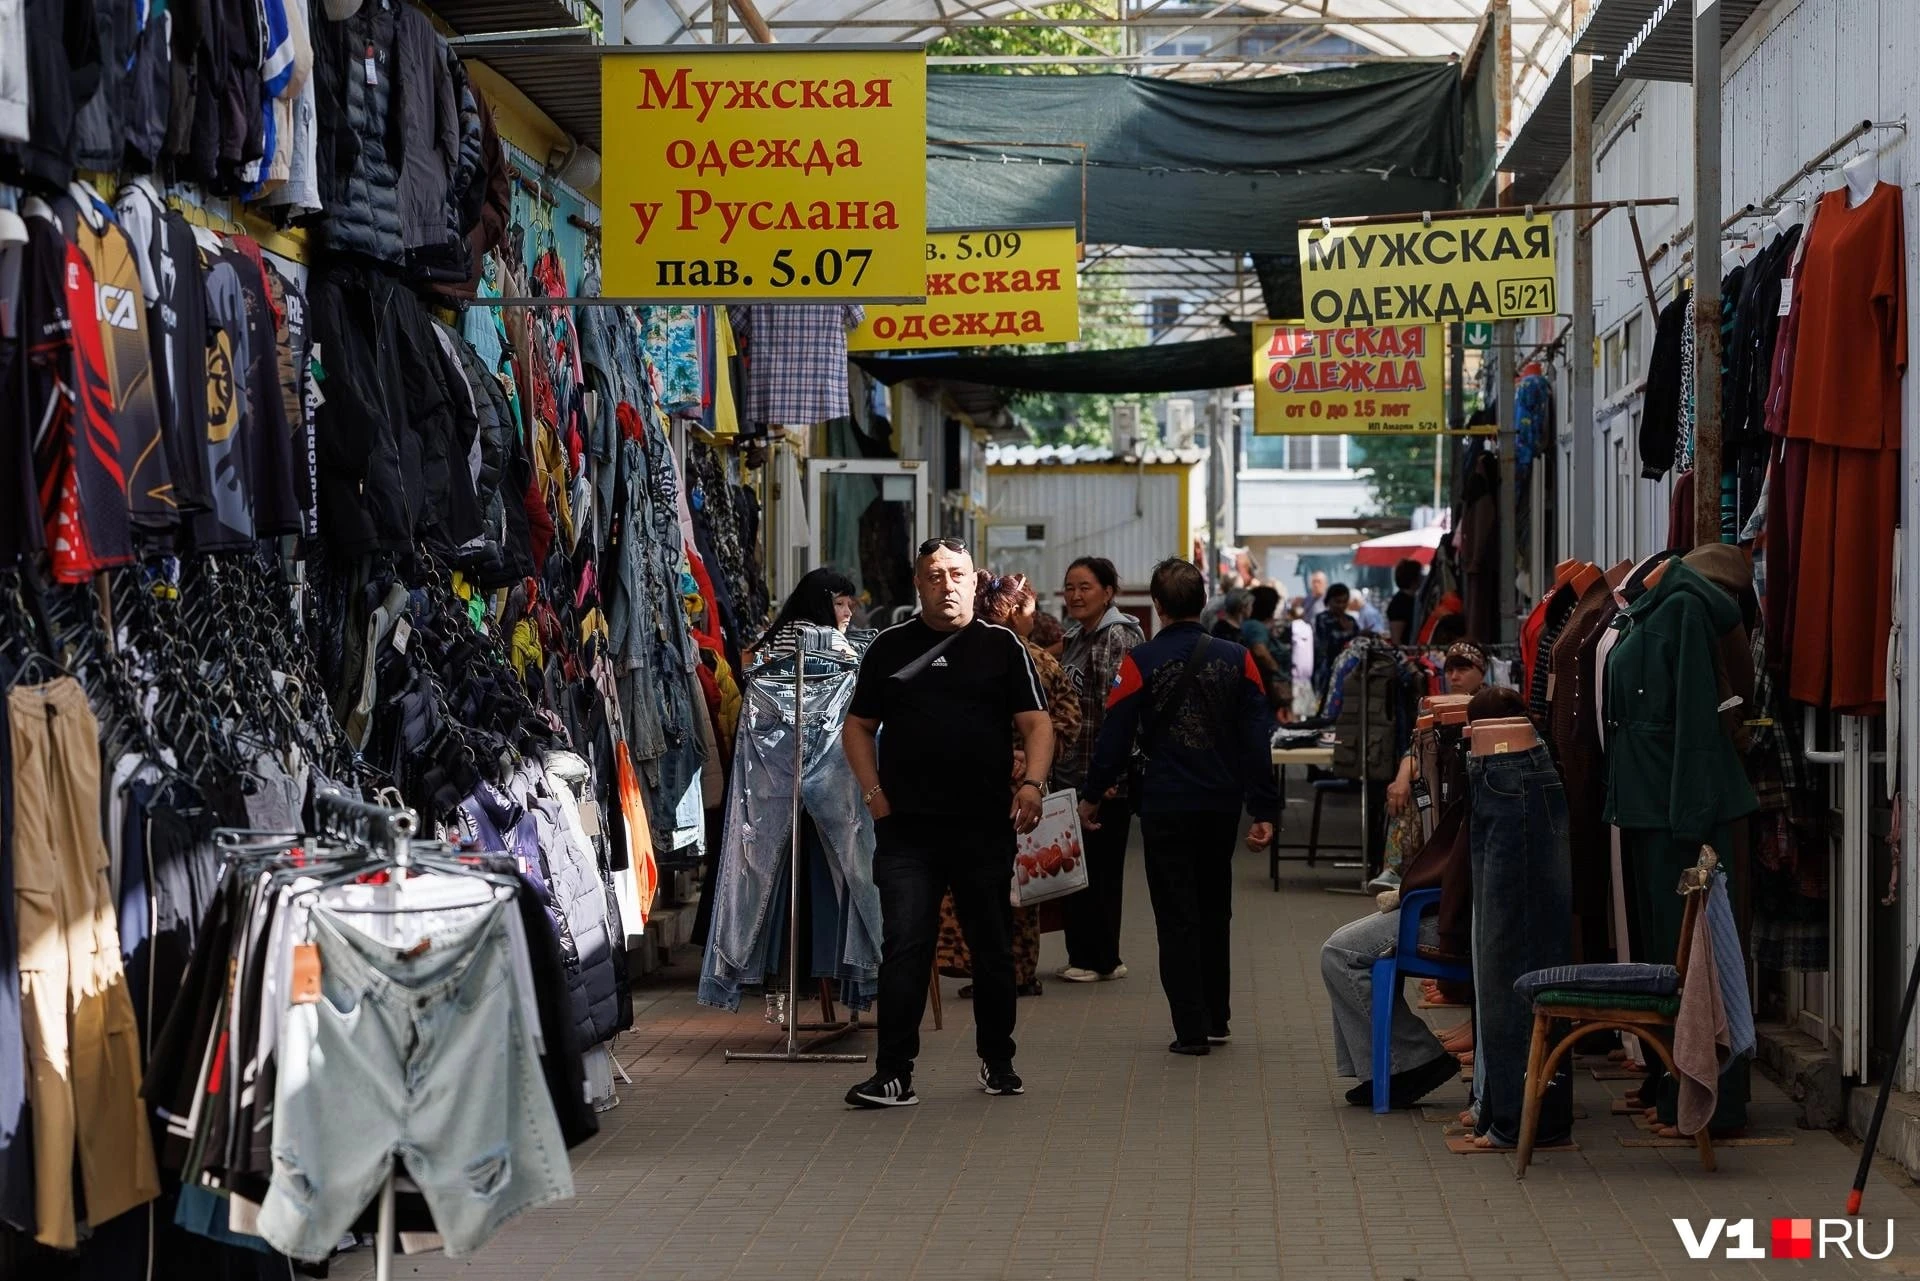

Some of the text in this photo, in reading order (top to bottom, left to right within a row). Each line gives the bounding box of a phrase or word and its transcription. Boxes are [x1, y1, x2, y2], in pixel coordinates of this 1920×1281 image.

[637, 67, 892, 123] Мужская
[665, 138, 862, 176] одежда
[630, 189, 899, 245] у Руслана
[957, 233, 1021, 260] 5.09
[1308, 224, 1550, 272] МУЖСКАЯ
[656, 249, 873, 288] пав. 5.07
[926, 268, 1061, 297] жская
[1310, 281, 1550, 328] ОДЕЖДА 5/21
[872, 310, 1044, 341] одежда
[1267, 325, 1425, 358] ДЕТСКАЯ
[1268, 360, 1426, 392] ОДЕЖДА
[1286, 399, 1411, 419] от 0 до 15 лет
[1418, 422, 1438, 430] 5/24
